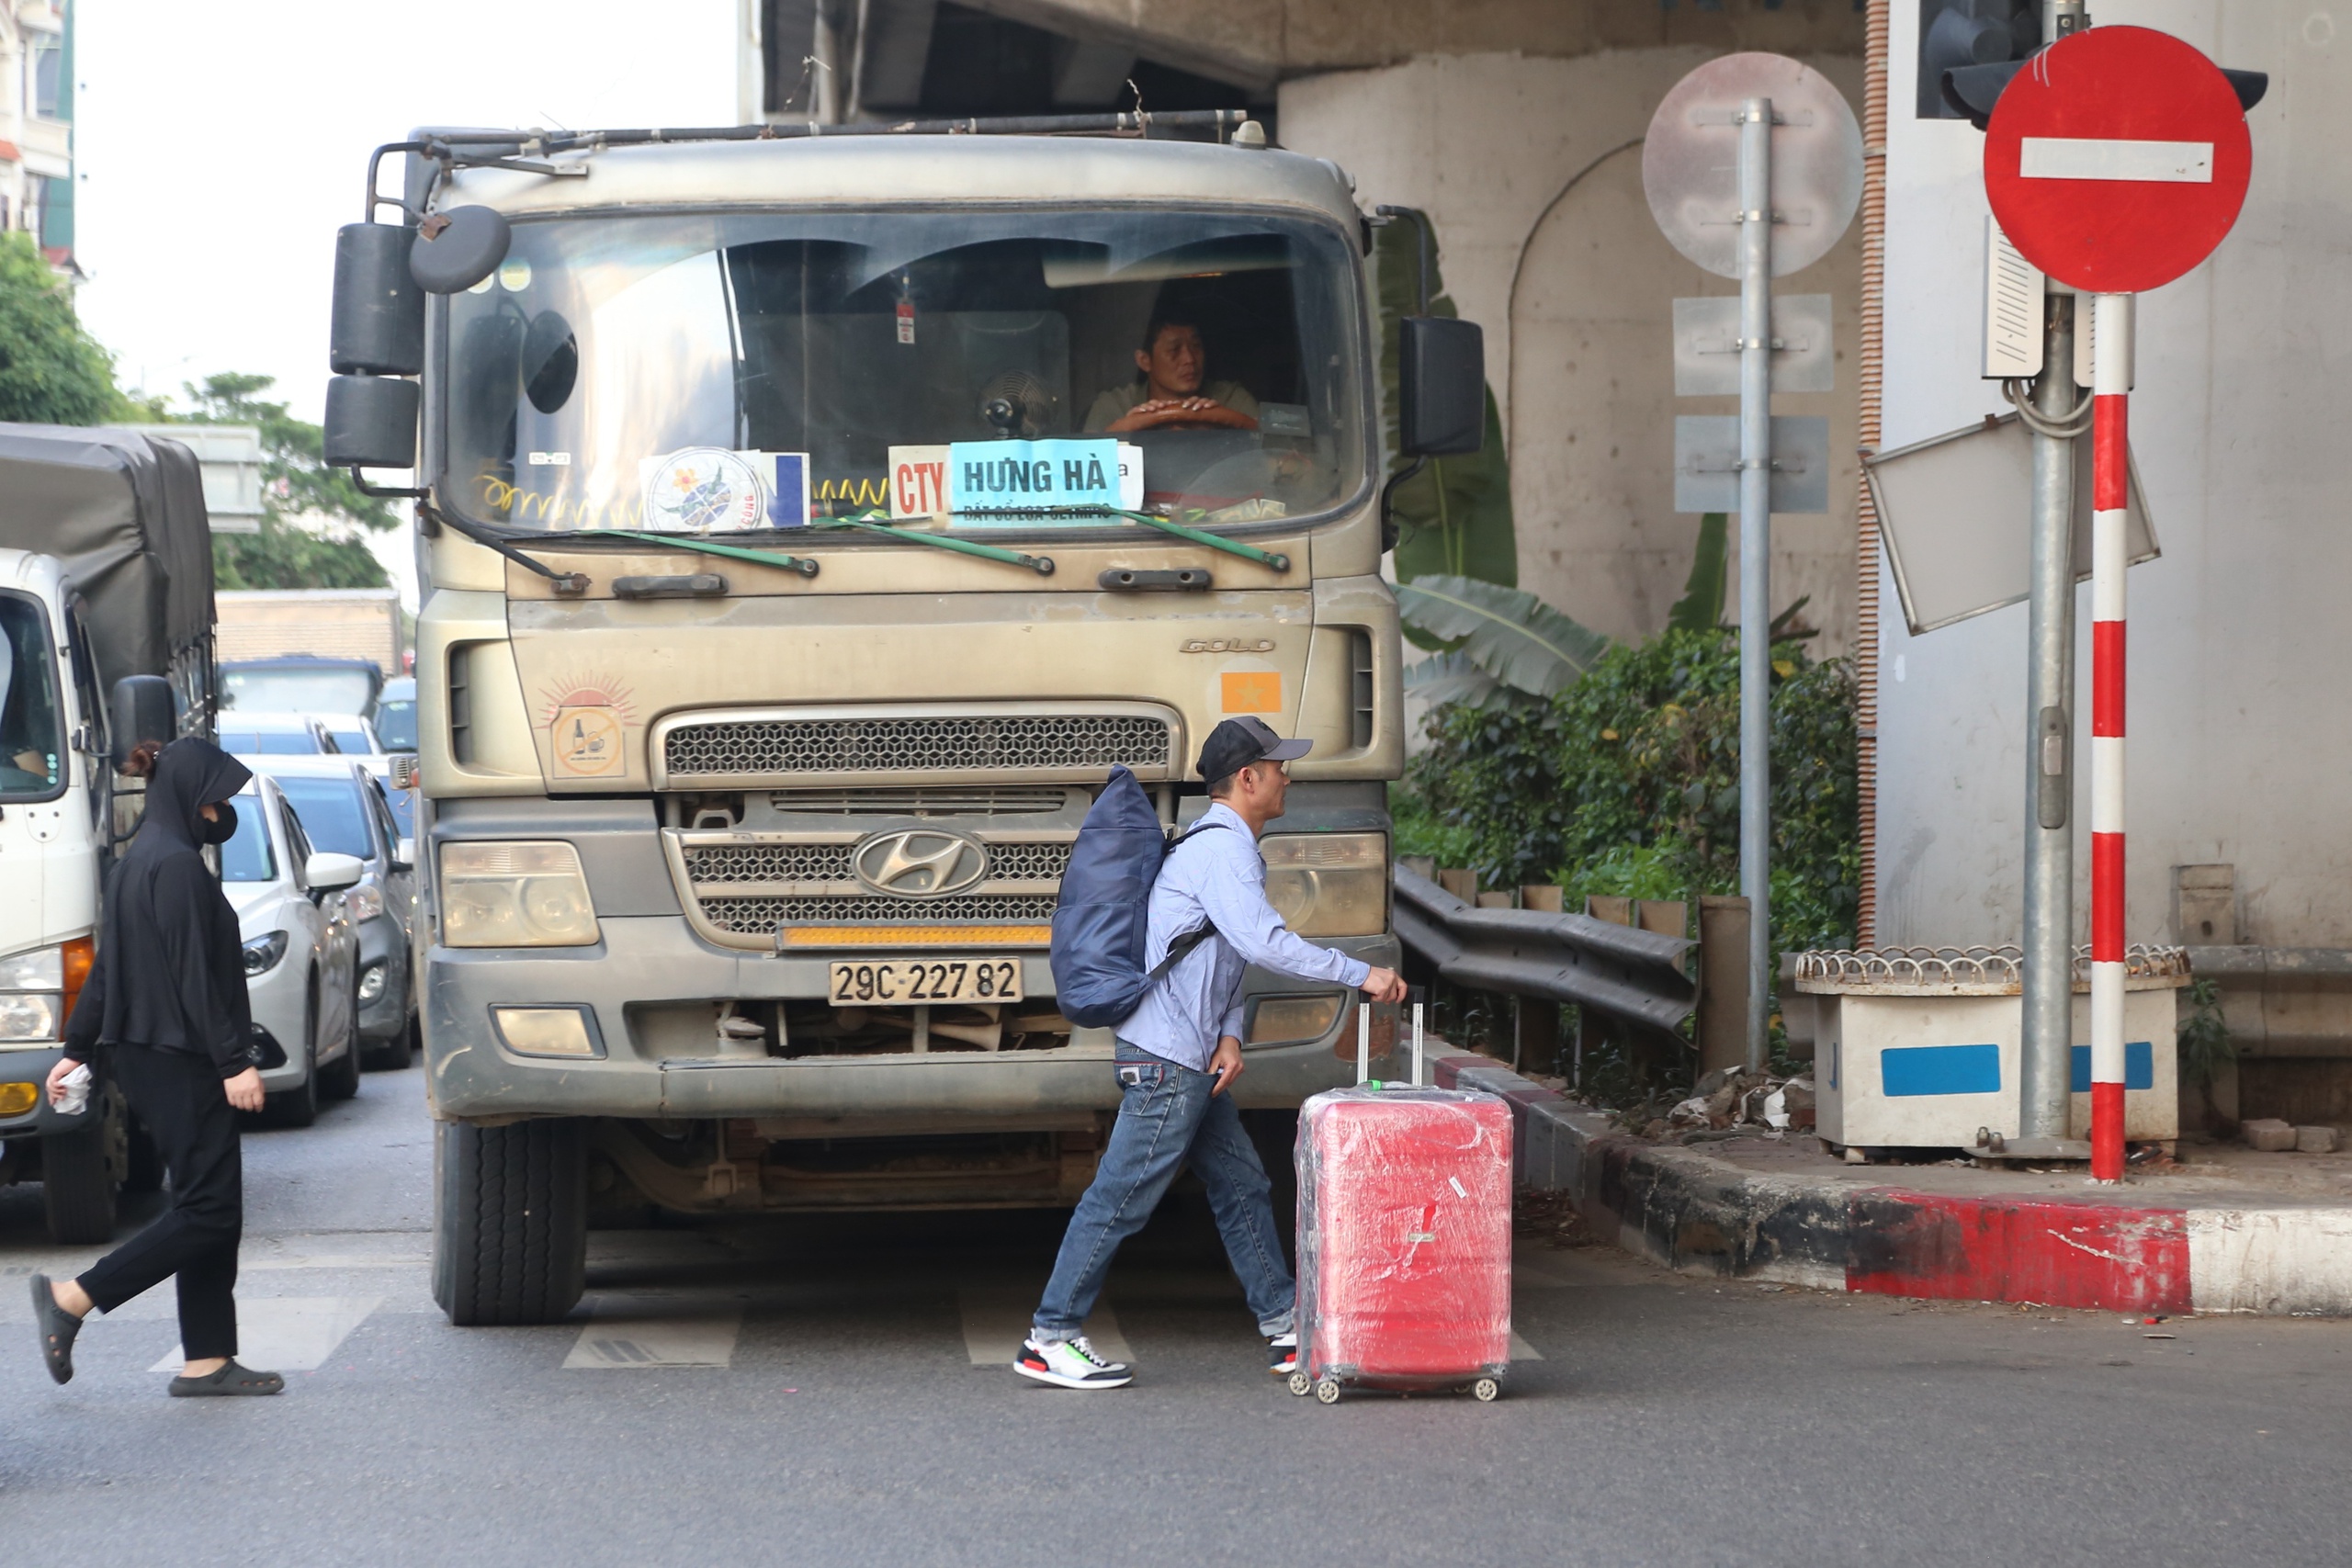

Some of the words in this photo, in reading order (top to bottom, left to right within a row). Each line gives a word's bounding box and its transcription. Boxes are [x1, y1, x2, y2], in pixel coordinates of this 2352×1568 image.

[898, 463, 944, 513] CTY
[964, 457, 1053, 493] HƯNG
[1063, 453, 1108, 490] HÀ
[1180, 638, 1275, 652] GOLD
